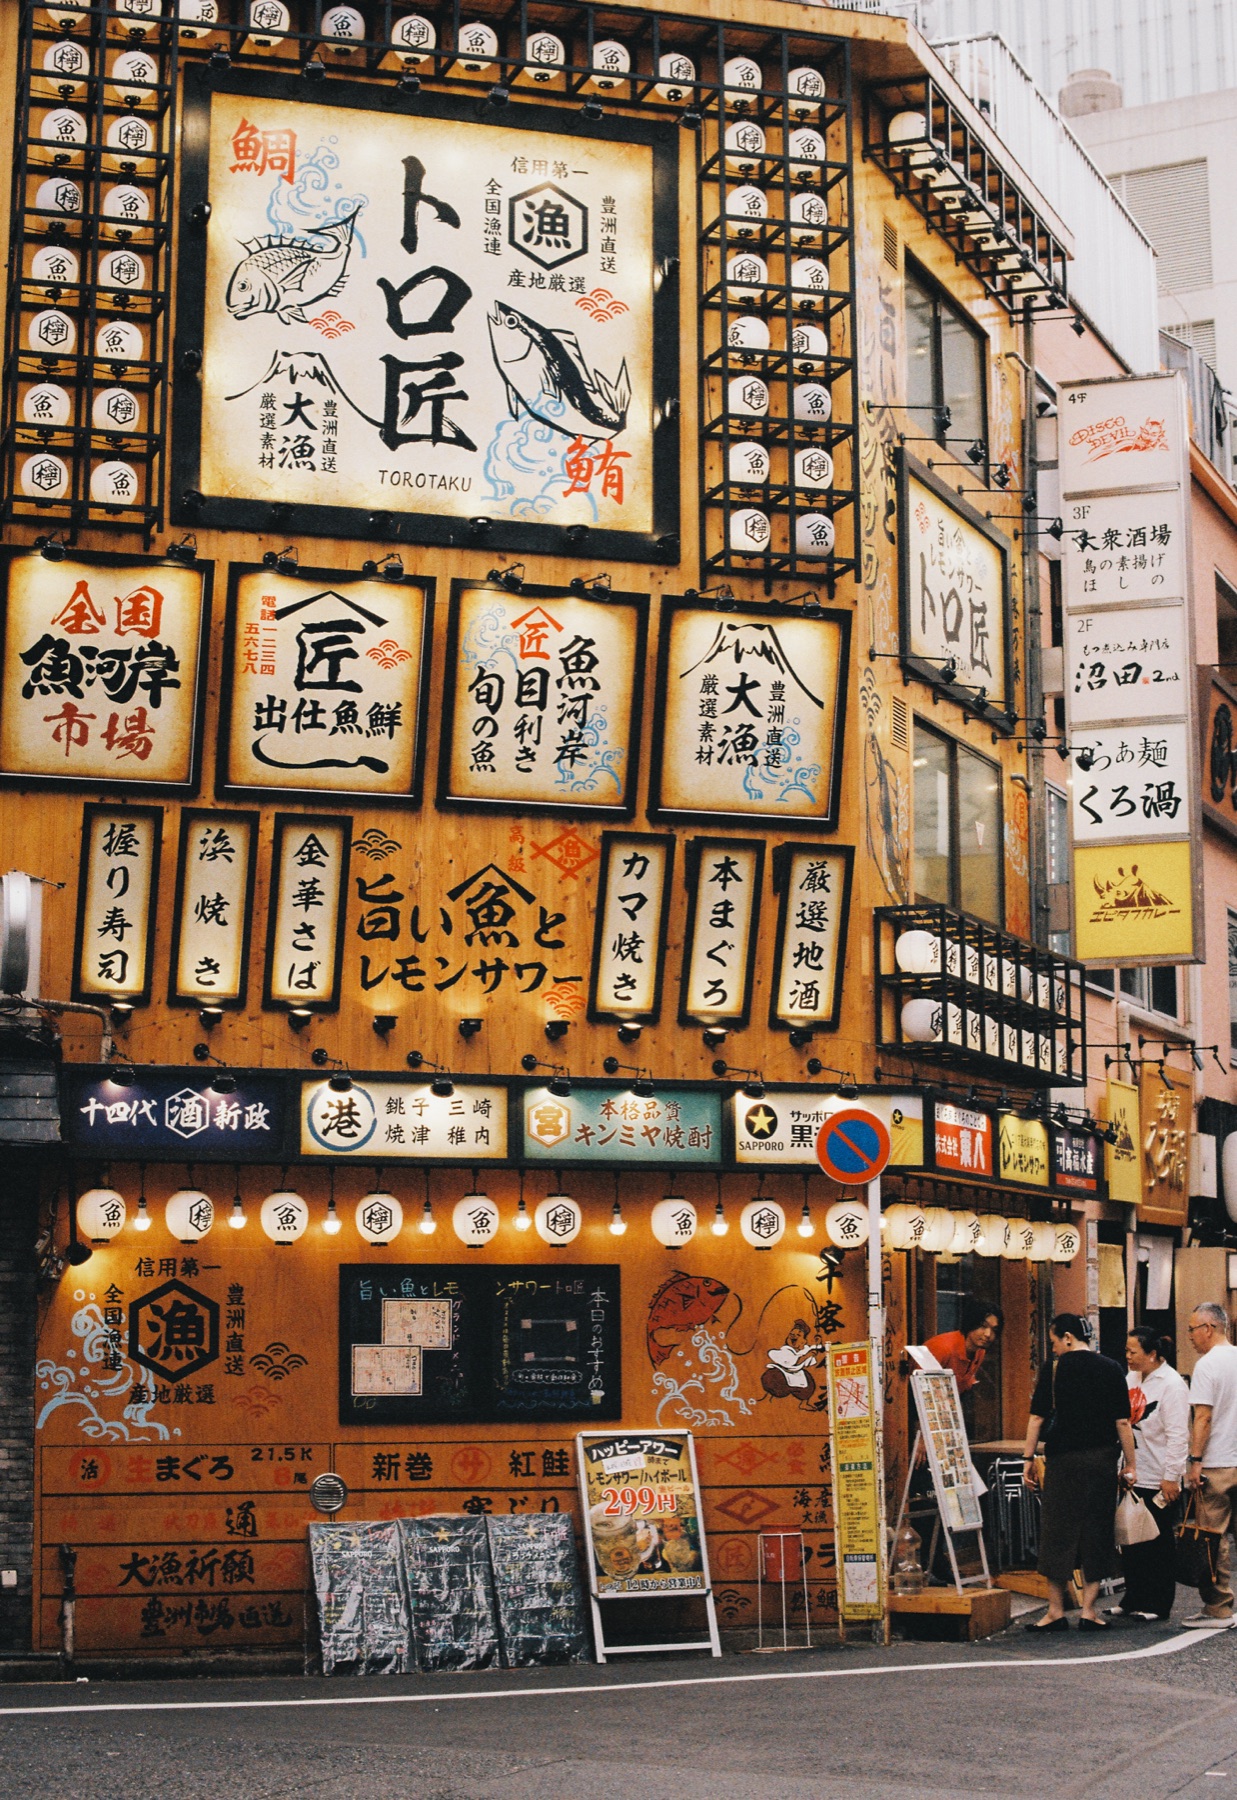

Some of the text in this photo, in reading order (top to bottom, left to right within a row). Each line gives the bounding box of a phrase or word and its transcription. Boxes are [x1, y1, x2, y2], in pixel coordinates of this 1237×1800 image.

[229, 117, 299, 184] 鯛
[510, 155, 590, 180] 信用第一
[482, 177, 503, 257] 全国漁連
[521, 198, 573, 250] 漁
[600, 195, 619, 275] 豊洲直送
[376, 155, 478, 452] トロ匠
[507, 269, 587, 295] 産地厳選
[258, 391, 279, 471] 厳選素材
[279, 391, 318, 473] 大漁
[320, 399, 340, 475] 豊洲直送
[378, 469, 473, 493] TOROTAKU
[562, 435, 633, 506] 鮪
[1073, 506, 1091, 520] 3F
[1083, 553, 1165, 574] 鳥の素揚げ
[51, 579, 165, 639] 全国
[919, 551, 992, 679] トロ匠
[1077, 619, 1093, 633] 2F
[19, 633, 182, 708] 魚河岸
[242, 622, 261, 675] 五六七八
[295, 619, 366, 693] 匠
[519, 622, 552, 661] 匠
[552, 634, 602, 770] 魚河岸
[1074, 661, 1180, 693] 沼田 2nd
[43, 701, 156, 761] 市場
[468, 667, 506, 774] 旬の魚
[513, 667, 551, 774] 目利き
[694, 673, 719, 767] 厳選素材
[717, 671, 764, 768] 大漁
[761, 680, 787, 770] 豊洲直送
[97, 822, 140, 984] 握り寿司
[194, 827, 236, 987] 浜焼き
[287, 832, 330, 990] 金華さば
[356, 873, 567, 949] 旨い魚と
[611, 852, 651, 1001] カマ焼き
[702, 855, 743, 1007] 本まぐろ
[1089, 906, 1181, 923] エピタフカレー
[788, 861, 831, 1012] 厳選地酒
[359, 954, 583, 994] レモンサワー
[79, 1097, 271, 1131] 十四代 酒 新政
[320, 1097, 362, 1138] 港
[385, 1097, 493, 1120] 銚子 三崎
[385, 1125, 491, 1147] 焼津 稚内
[574, 1124, 713, 1150] キンミヤ焼酎
[600, 1099, 682, 1122] 本格品質
[738, 1140, 785, 1152] SAPPORO
[135, 1257, 221, 1278] 信用第一
[102, 1283, 124, 1371] 全国漁連
[147, 1300, 205, 1361] 漁
[224, 1282, 246, 1376] 豊洲直送
[128, 1383, 216, 1405] 産地厳選
[372, 1452, 433, 1481] 新巻
[508, 1450, 570, 1480] 紅鮭
[591, 1439, 678, 1461] ハッピーアワー
[225, 1501, 258, 1537] 通
[117, 1548, 255, 1587] 大漁祈願
